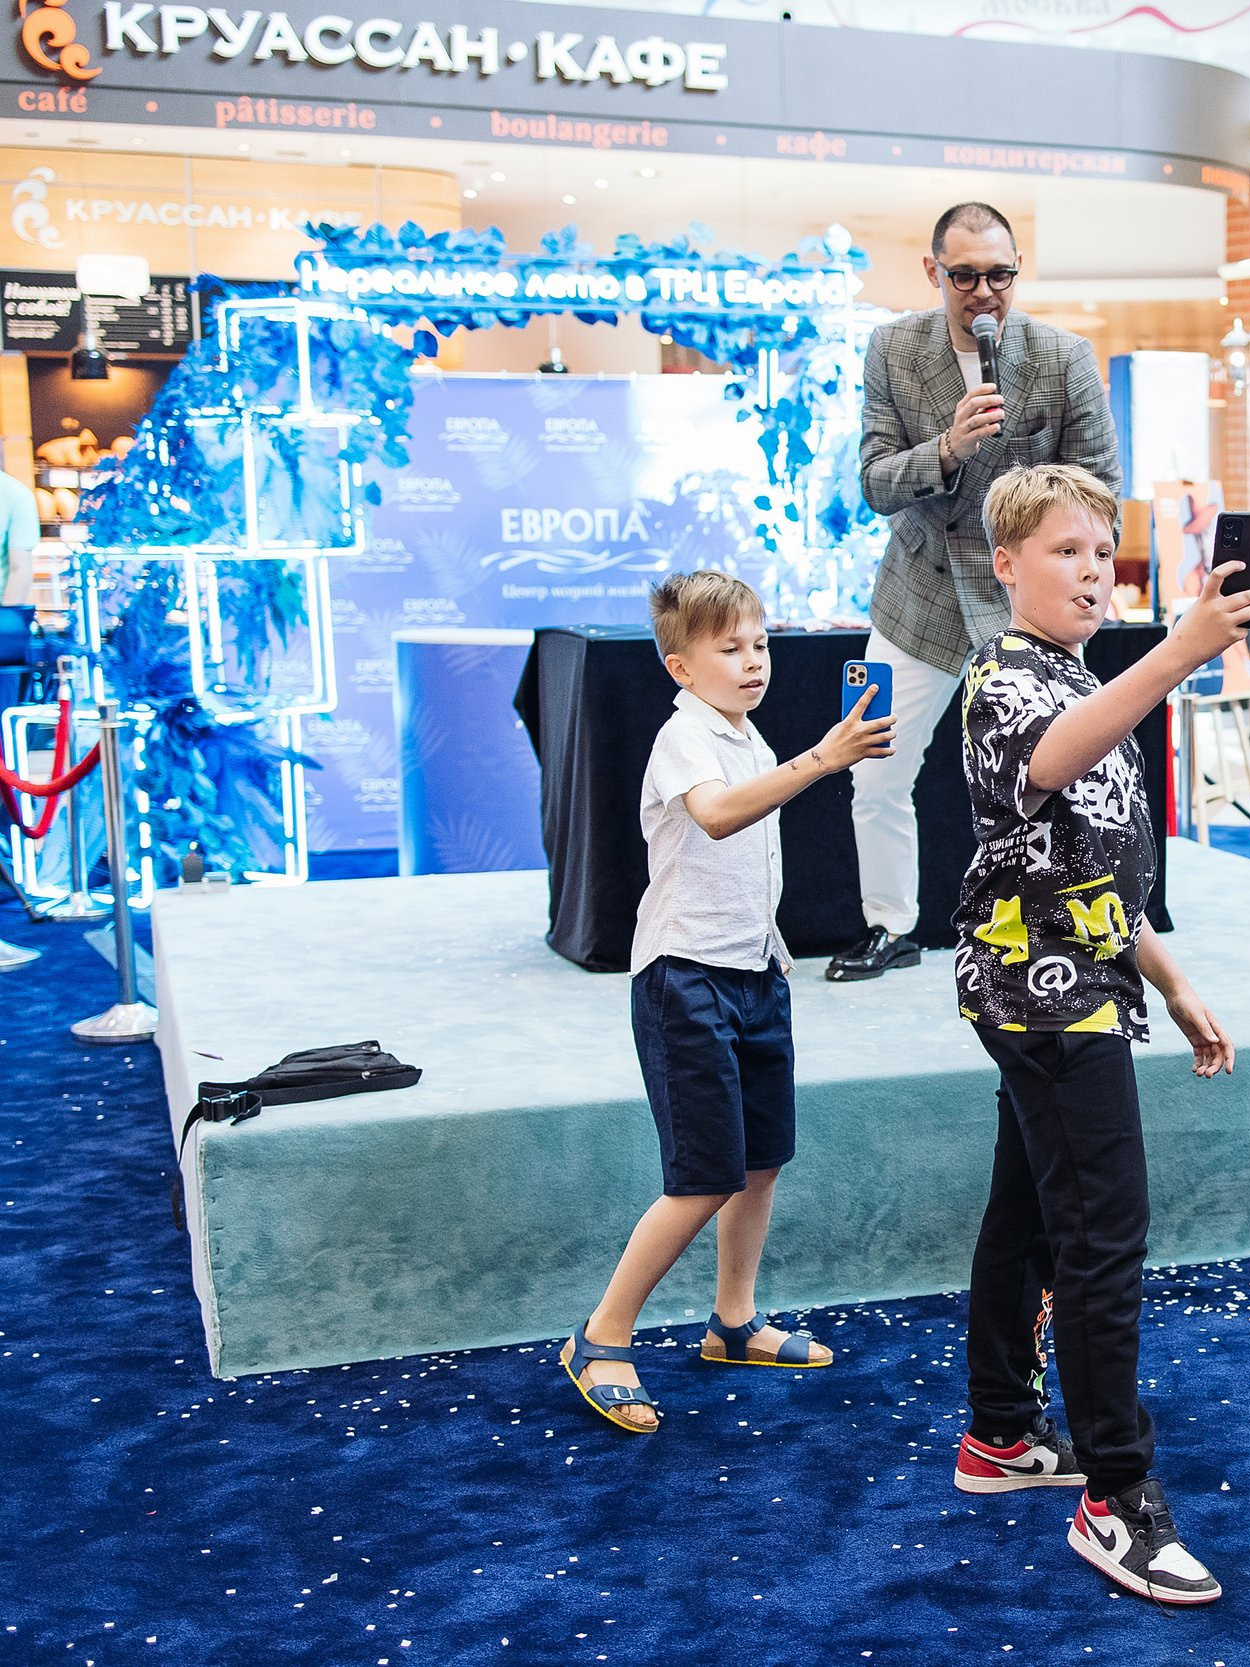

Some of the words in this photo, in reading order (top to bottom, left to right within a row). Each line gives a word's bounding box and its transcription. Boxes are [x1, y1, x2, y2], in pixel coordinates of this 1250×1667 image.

[105, 1, 499, 75] КРУАССАН
[536, 31, 728, 90] КАФЕ
[18, 87, 88, 114] café
[214, 96, 377, 129] pâtisserie
[490, 110, 669, 149] boulangerie
[776, 130, 847, 162] кафе
[943, 145, 1127, 176] кондитерская
[65, 198, 253, 228] КРУАССАН
[525, 272, 621, 299] лето
[650, 267, 720, 307] ТРЦ
[501, 508, 650, 543] ЕВРОПА
